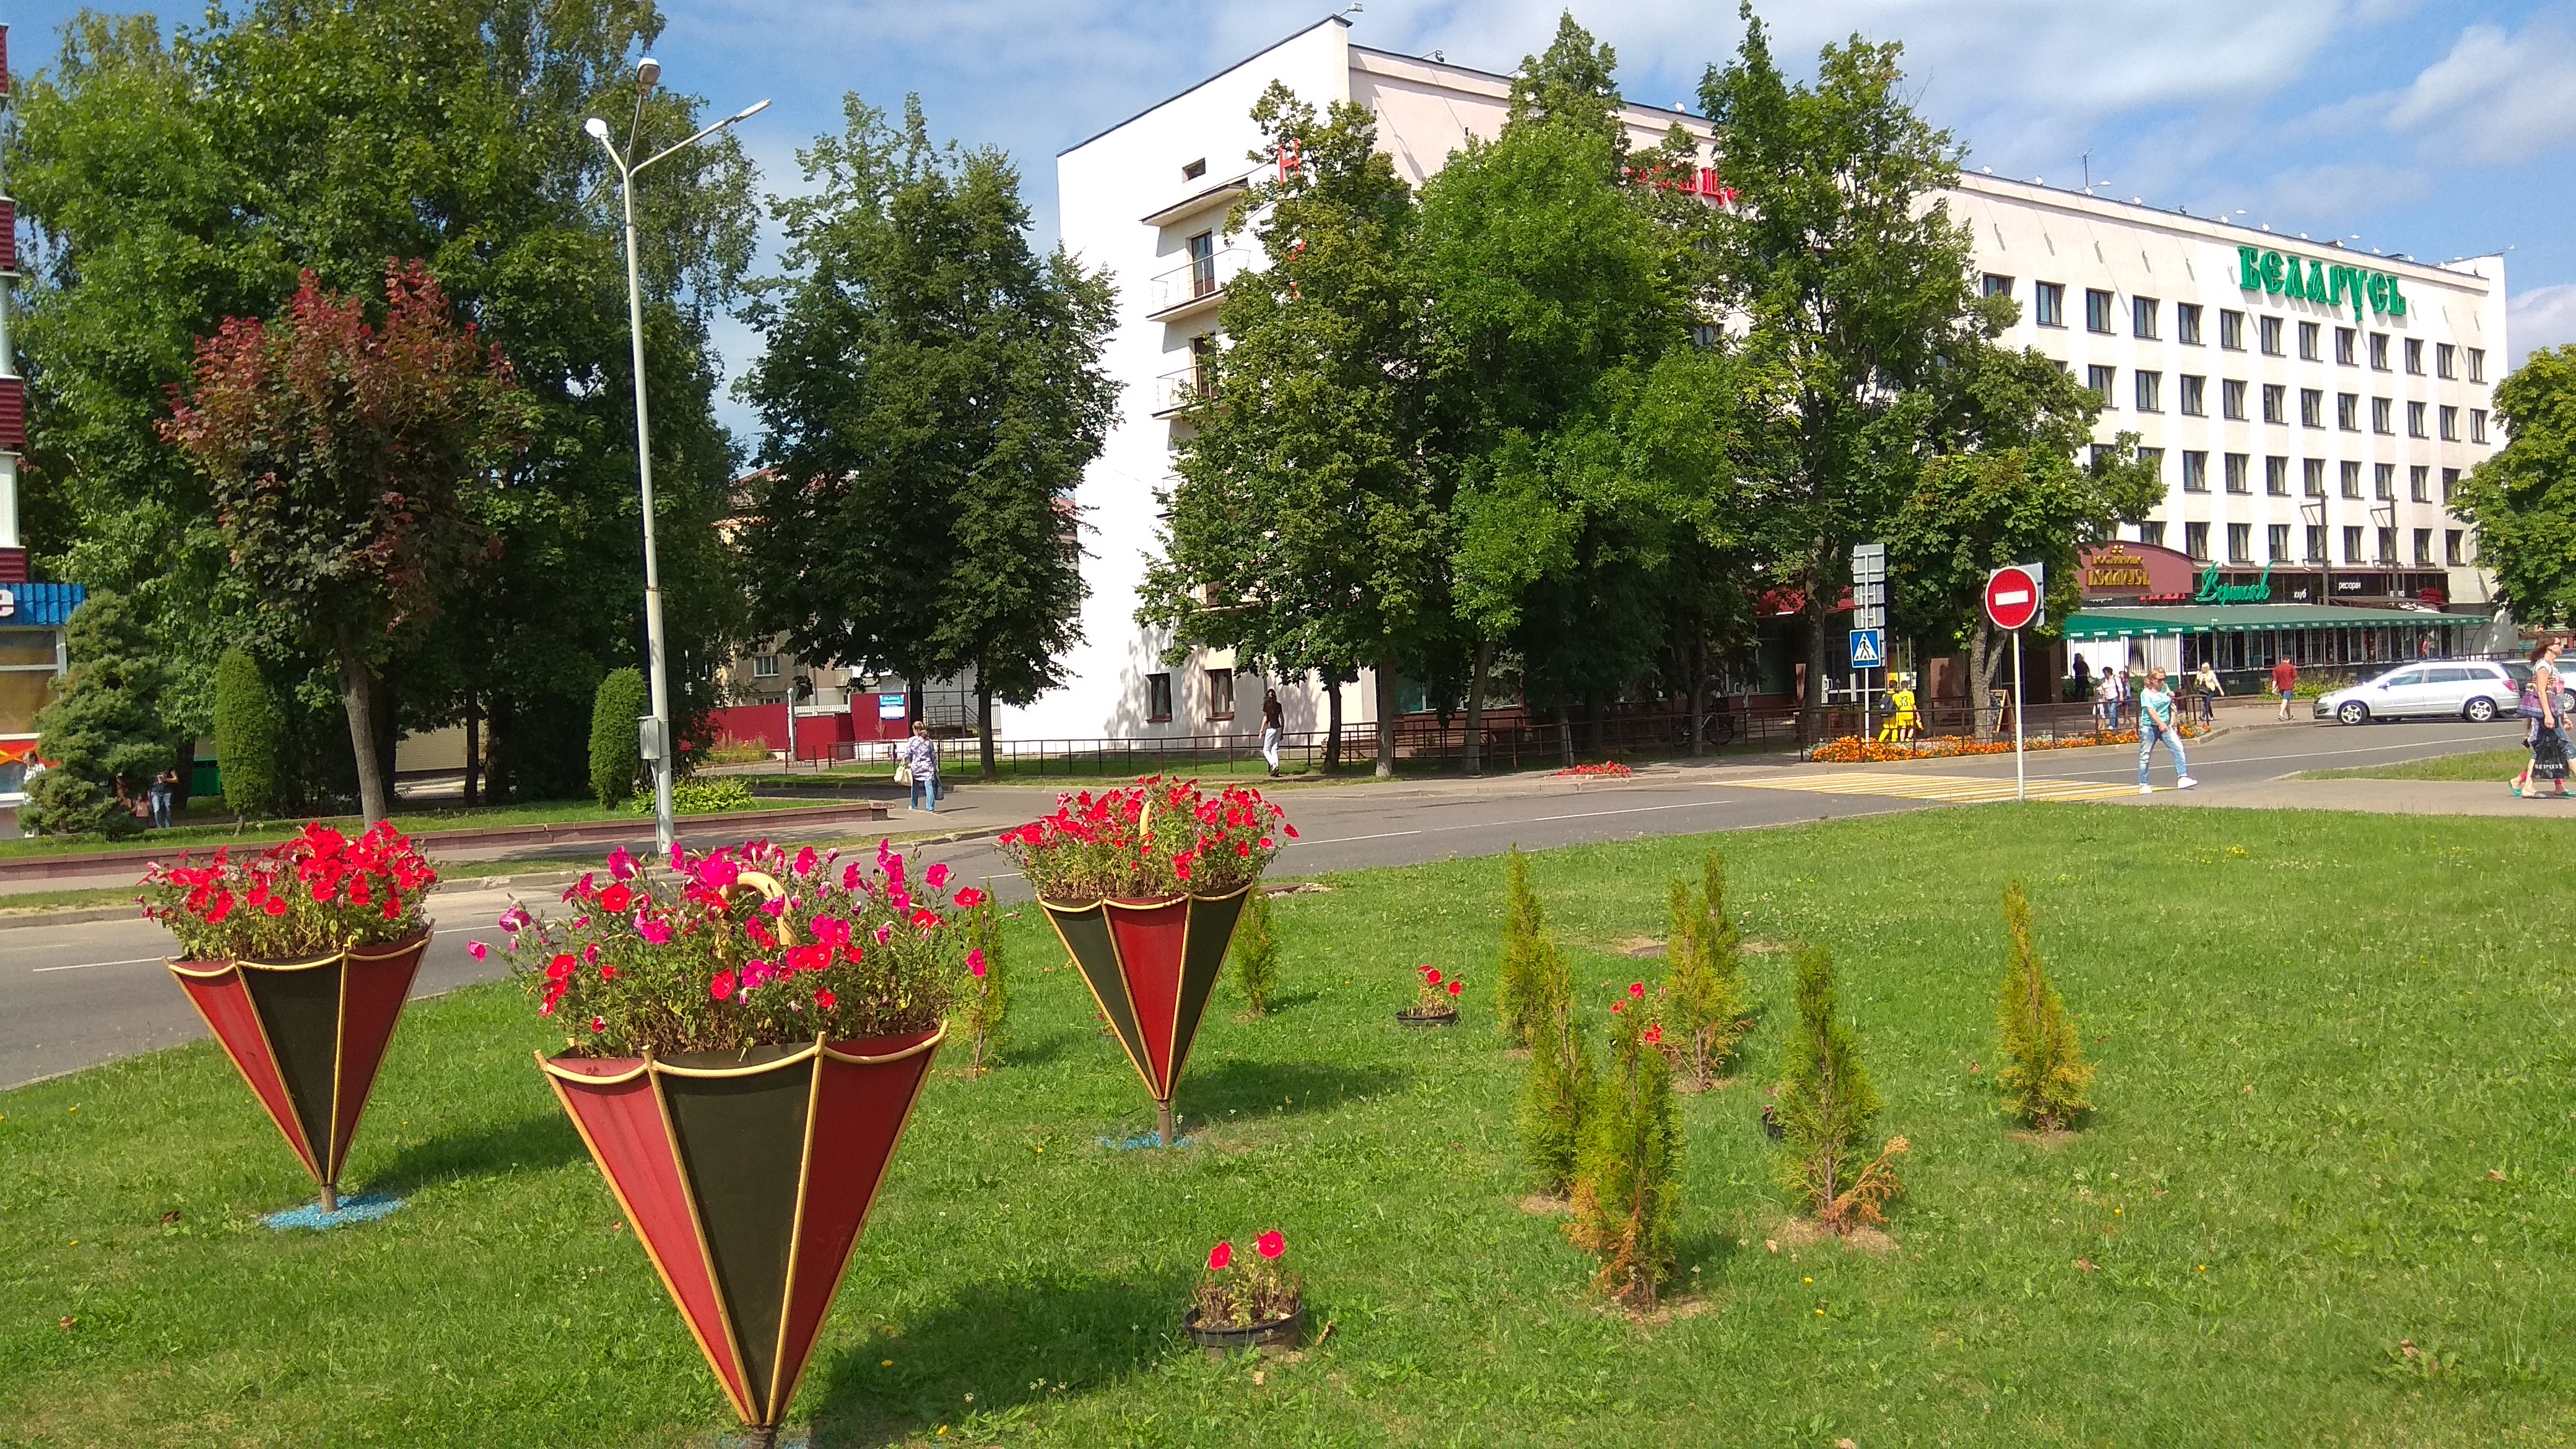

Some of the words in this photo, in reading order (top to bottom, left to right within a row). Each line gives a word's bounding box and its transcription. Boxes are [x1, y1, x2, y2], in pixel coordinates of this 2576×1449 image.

[2237, 246, 2406, 322] БЕЛАРУСЬ
[2338, 581, 2361, 591] ресторан
[2294, 588, 2307, 600] клуб
